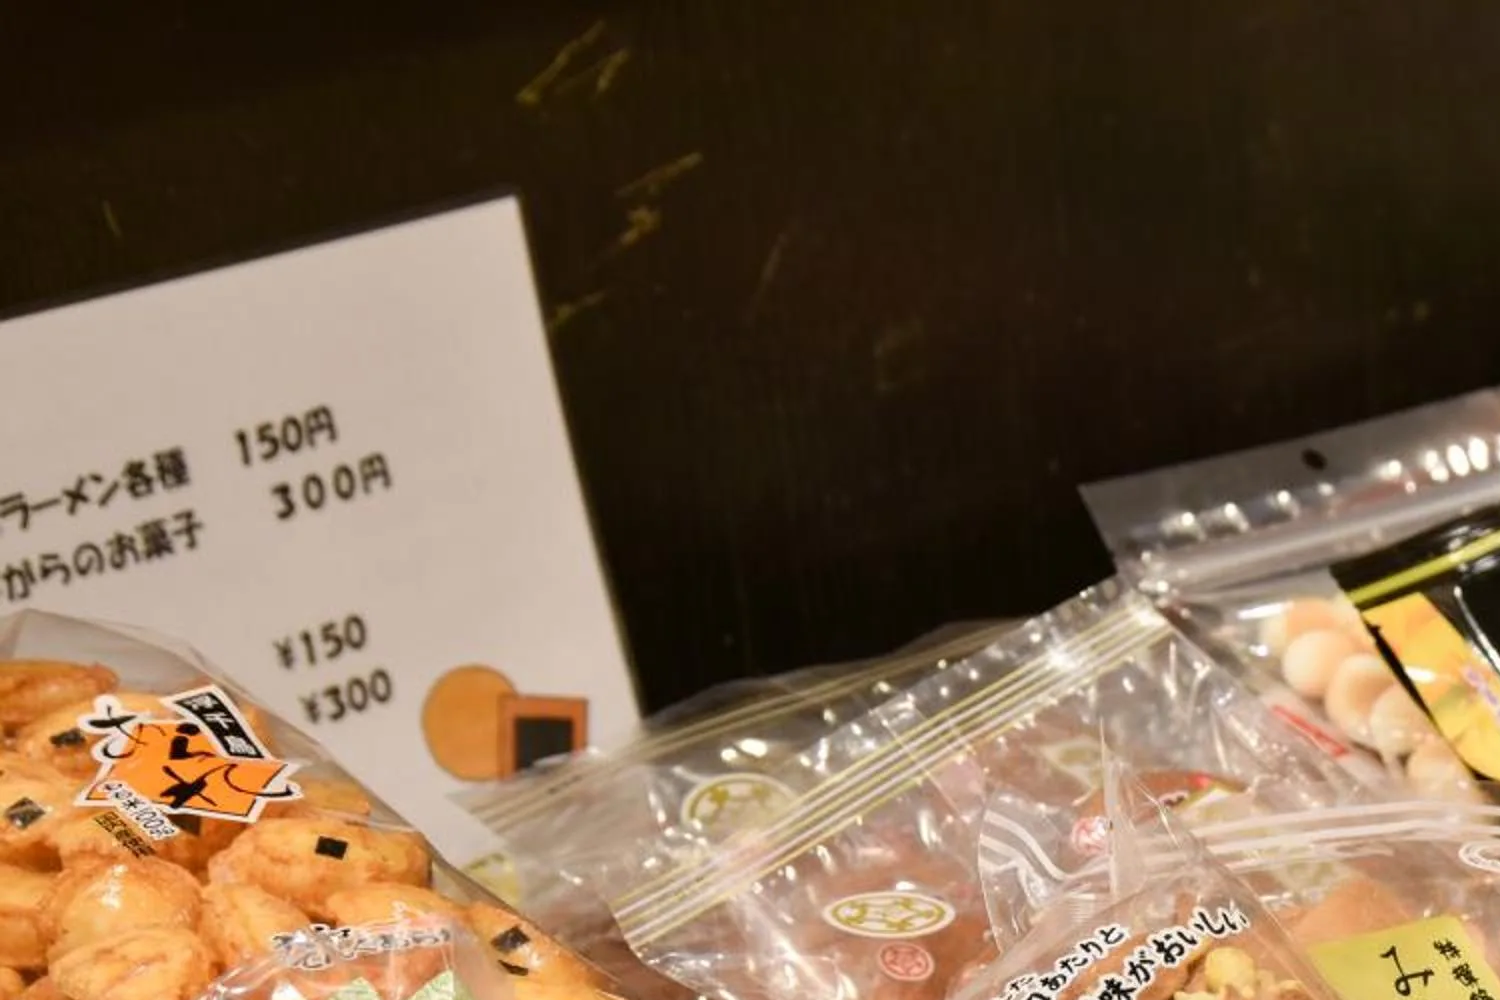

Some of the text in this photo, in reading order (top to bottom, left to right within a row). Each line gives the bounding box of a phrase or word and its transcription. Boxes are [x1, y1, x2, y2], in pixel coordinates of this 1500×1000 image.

[235, 405, 338, 466] 150円
[271, 453, 393, 520] 300円
[272, 613, 366, 670] ¥150
[300, 669, 393, 724] ¥300
